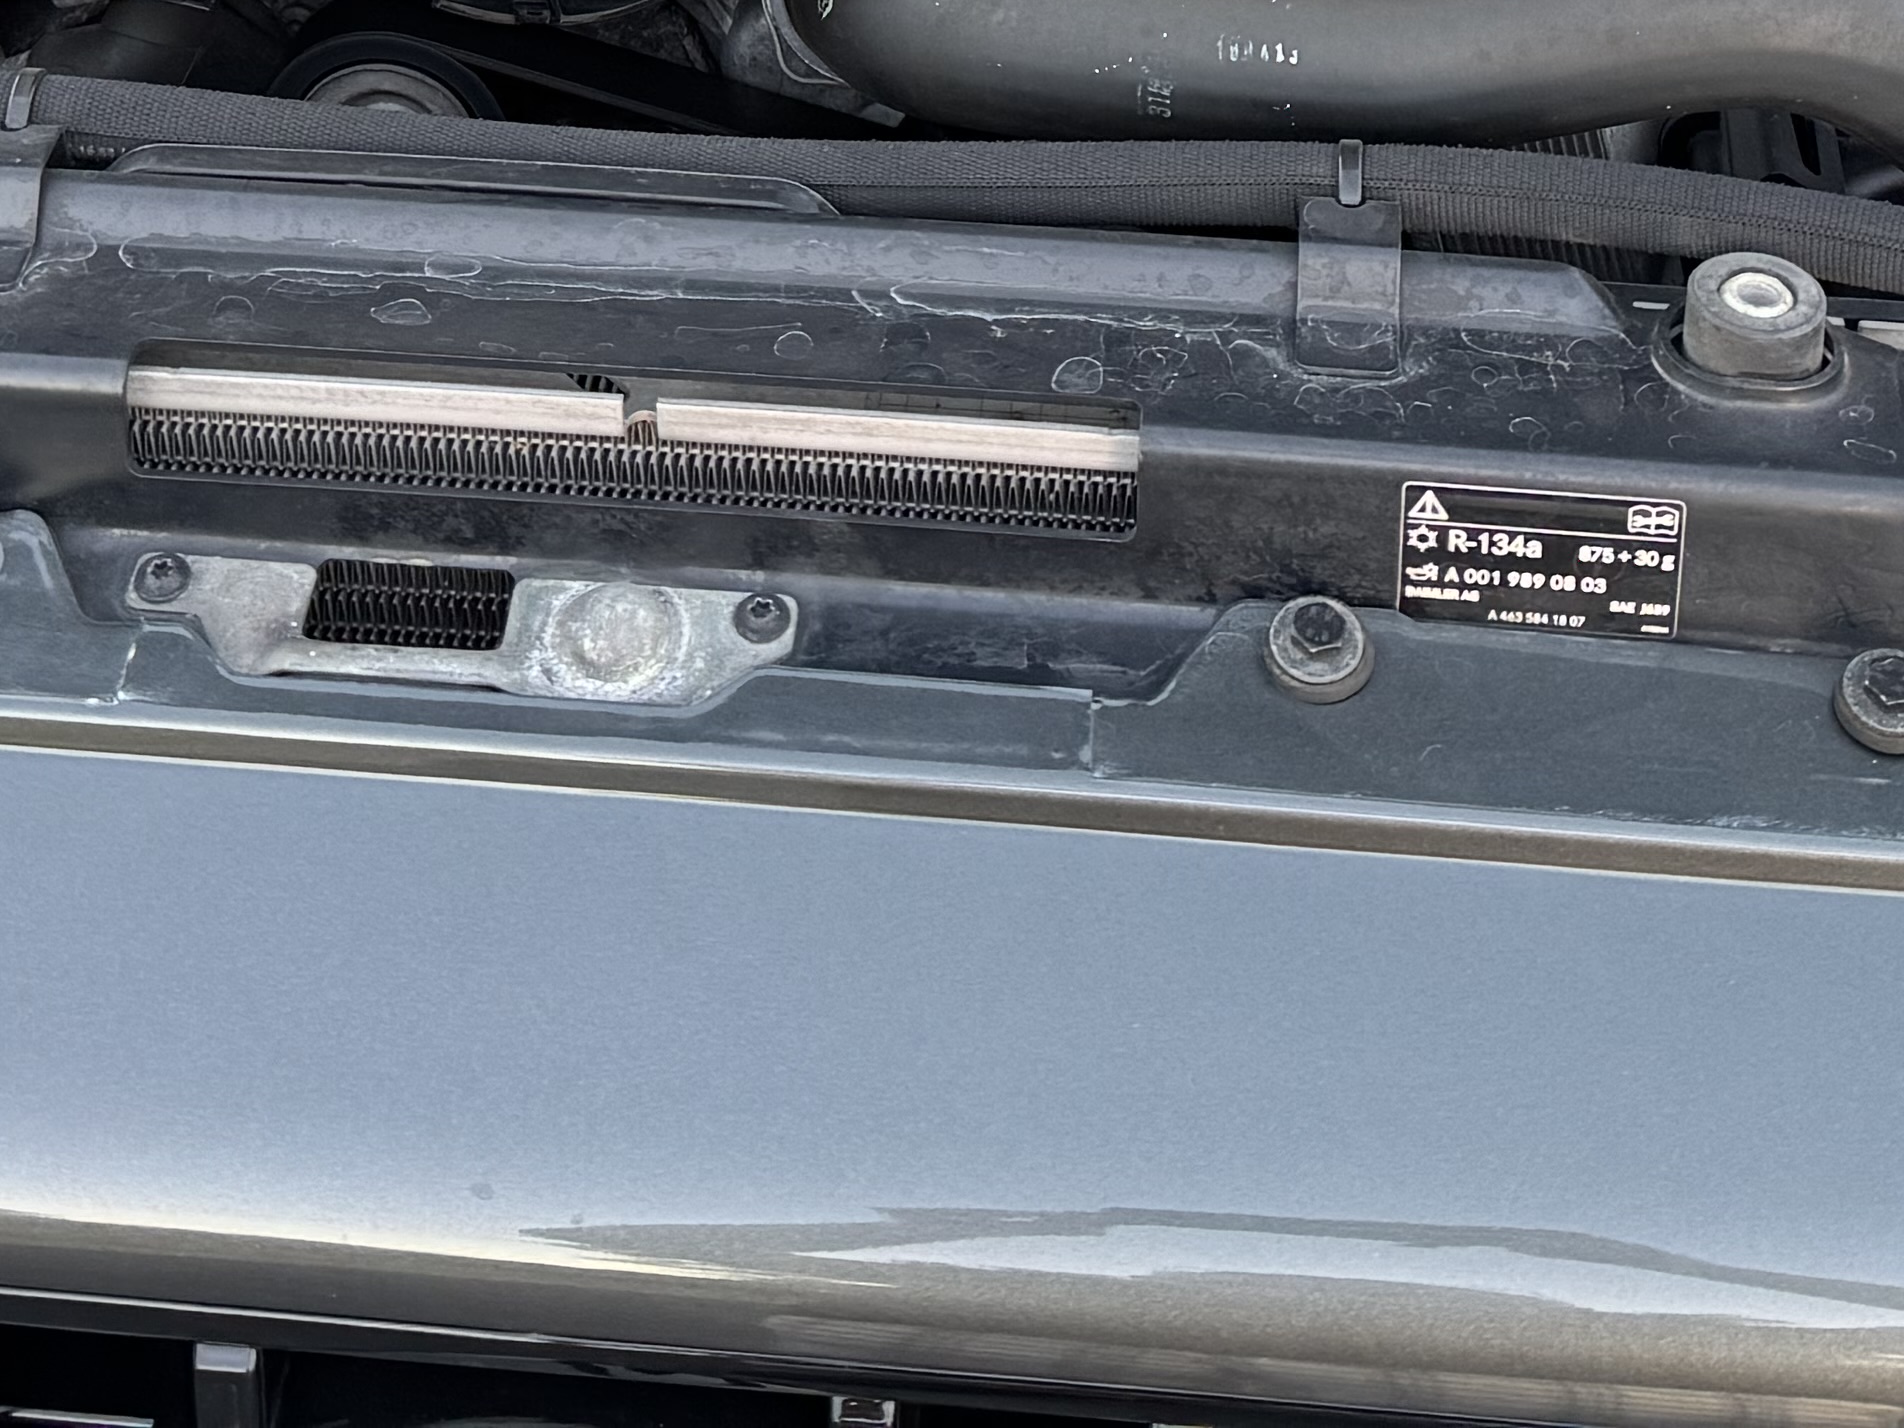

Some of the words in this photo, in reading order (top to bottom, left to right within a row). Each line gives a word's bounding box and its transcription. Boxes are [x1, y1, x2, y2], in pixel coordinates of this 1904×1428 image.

[1447, 529, 1544, 559] R-134a
[1577, 544, 1616, 565] 875
[1633, 549, 1660, 568] 30
[1660, 554, 1676, 572] g
[1443, 565, 1460, 583] A
[1463, 567, 1502, 586] 001
[1506, 570, 1546, 590] 989
[1549, 573, 1576, 592] 08
[1580, 575, 1608, 595] 03
[1487, 609, 1498, 621] A
